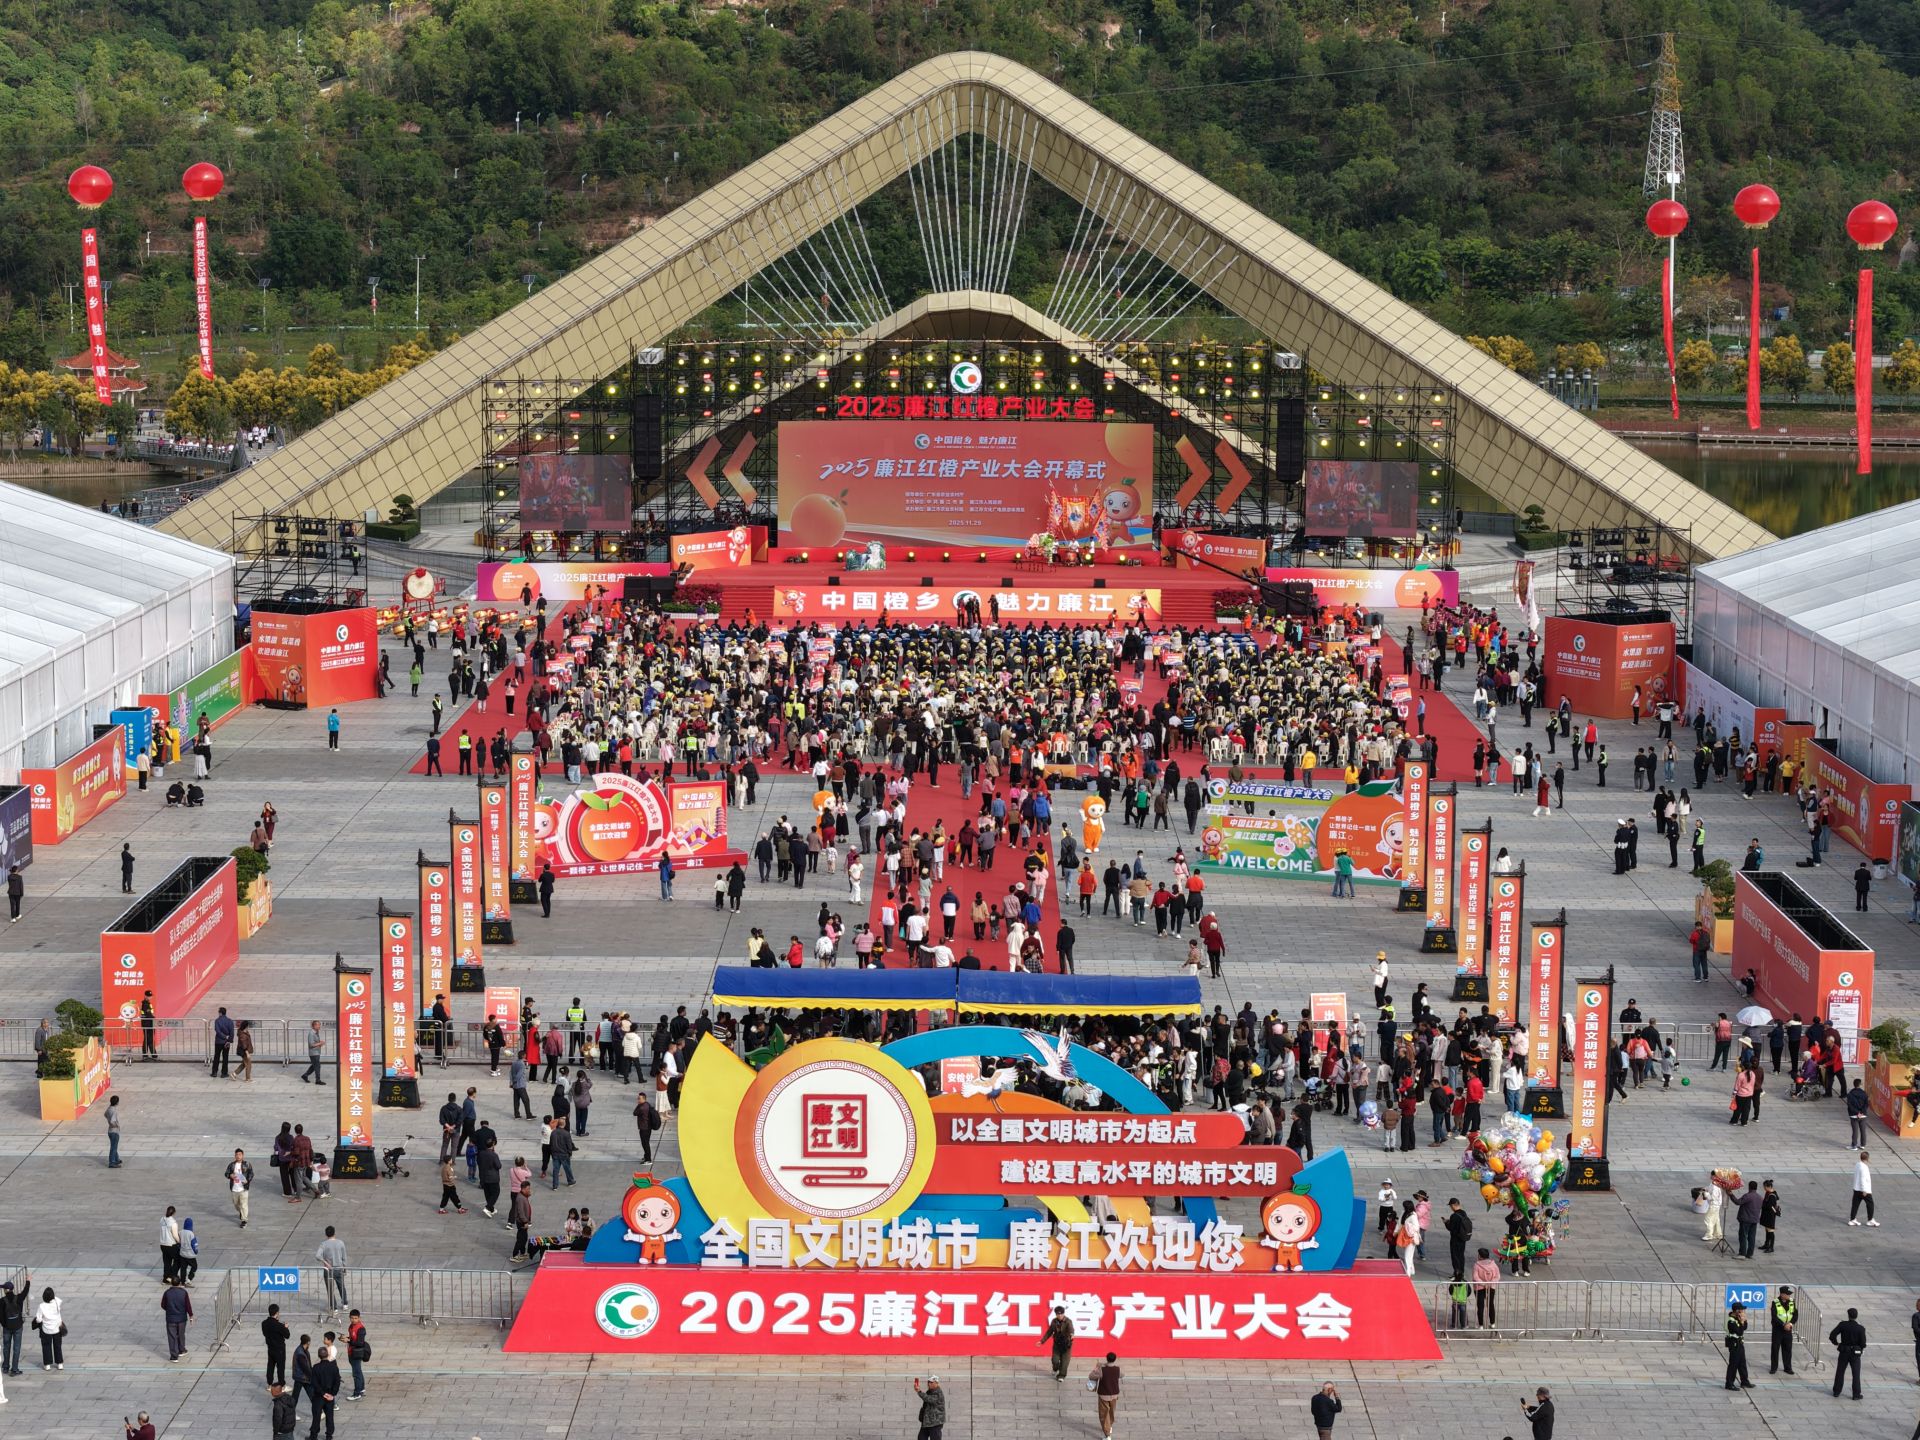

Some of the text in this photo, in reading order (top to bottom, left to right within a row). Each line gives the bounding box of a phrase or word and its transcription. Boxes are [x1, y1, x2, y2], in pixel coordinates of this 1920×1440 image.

[85, 233, 109, 398] 中国橙乡 魅力廉江
[836, 396, 1096, 419] 2025廉江红橙产业大会
[934, 436, 1017, 446] 中国橙乡 魅力廉江
[819, 457, 1107, 480] 2025 廉江红橙产业大会开幕式
[821, 591, 1115, 612] 中国橙乡 魅力廉江
[1229, 784, 1334, 801] 2025廉江红橙产业大会
[518, 783, 528, 858] 廉江红橙产业大会
[589, 822, 631, 832] 全国文明城市
[1229, 819, 1279, 830] 中国红橙之乡
[1329, 815, 1353, 823] 一颗橙子
[1329, 823, 1377, 832] 让世界记住一座城
[1408, 783, 1420, 866] 中国橙乡 魅力廉江
[592, 831, 628, 840] 廉江欢迎您
[1233, 832, 1275, 842] 廉江欢迎您
[490, 809, 503, 897] 一颗橙子 让世界记住一座城 廉江
[1230, 855, 1313, 872] WELCOME
[1434, 816, 1446, 905] 全国文明城市 廉江欢迎您
[560, 865, 596, 876] 一颗橙子
[461, 847, 475, 941] 全国文明城市 廉江欢迎您
[1465, 857, 1479, 950] 一颗橙子 让世界记住一座城 廉江
[430, 892, 443, 990] 中国橙乡 魅力廉江
[1496, 911, 1513, 1001] 廉江红橙产业大会
[113, 978, 144, 986] 魅力廉江
[391, 943, 406, 1049] 中国橙乡 魅力廉江
[1537, 953, 1551, 1060] 一颗橙子 让世界记住一座城 廉江
[348, 1012, 363, 1116] 廉江红橙产业大会
[947, 1072, 975, 1083] 安检处
[1581, 1011, 1600, 1128] 全国文明城市 廉江欢迎您
[950, 1117, 1197, 1144] 以全国文明城市为起点
[1000, 1159, 1277, 1186] 建设更高水平的城市文明
[700, 1217, 1245, 1272] 全国文明城市 廉江欢迎您
[680, 1290, 1353, 1342] 2025廉江红橙产业大会
